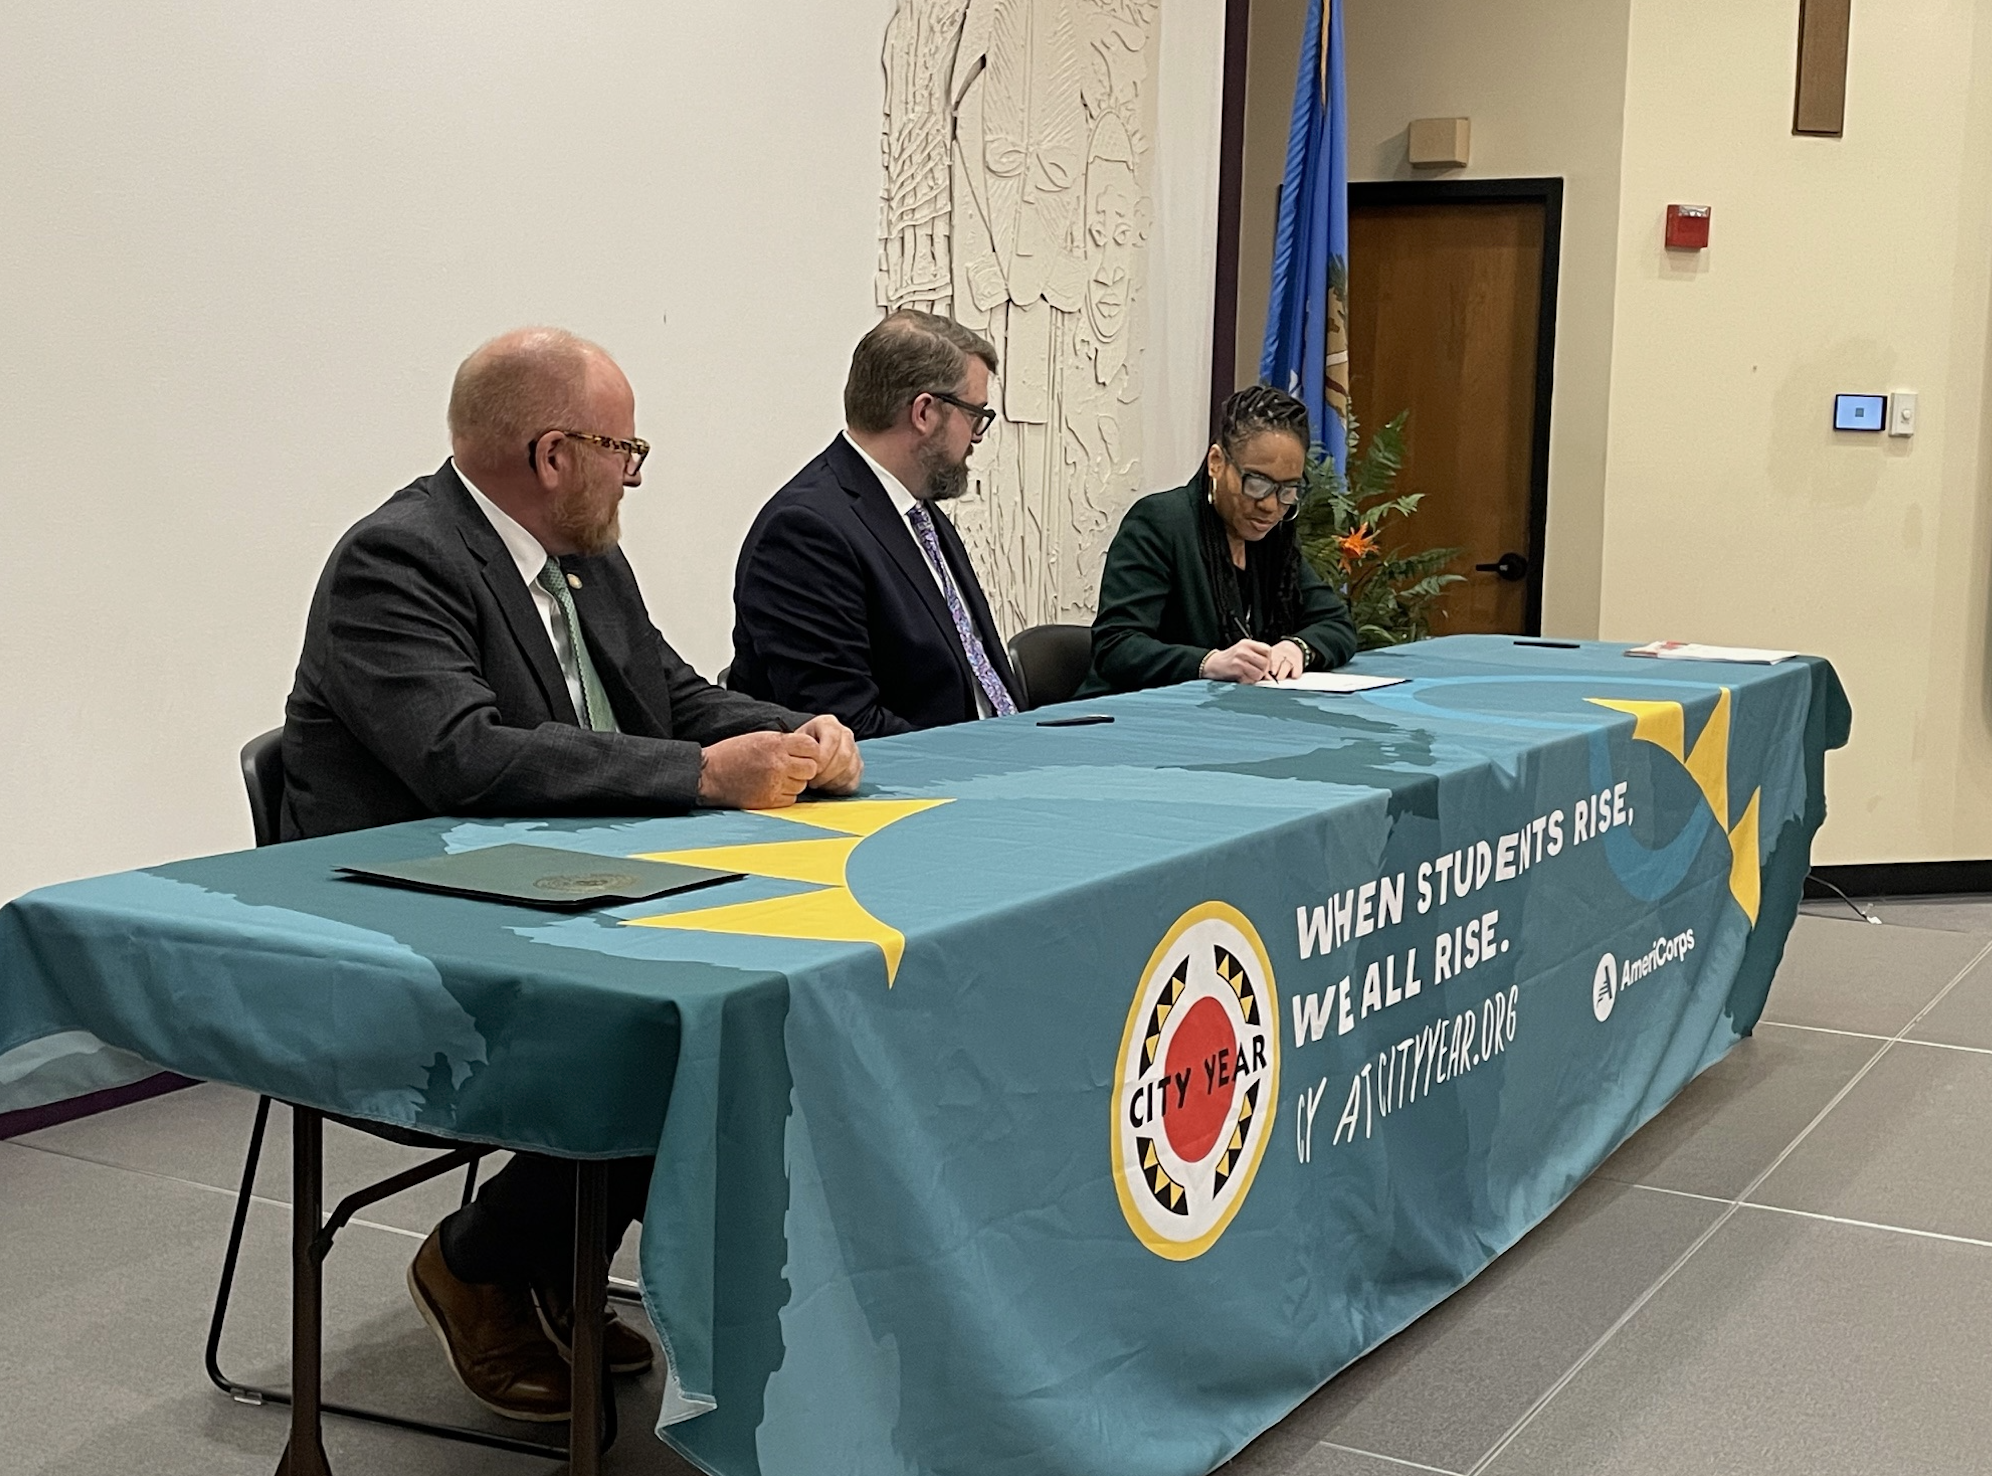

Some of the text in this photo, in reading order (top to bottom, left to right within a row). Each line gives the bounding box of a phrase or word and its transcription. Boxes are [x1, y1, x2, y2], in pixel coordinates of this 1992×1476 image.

[1296, 780, 1634, 960] WHEN STUDENTS RISE,
[1292, 909, 1510, 1049] WE ALL RISE.
[1620, 928, 1695, 992] AmeriCorps
[1129, 1034, 1268, 1129] CITY YEAR
[1377, 984, 1519, 1118] CITYYEAR.ORG
